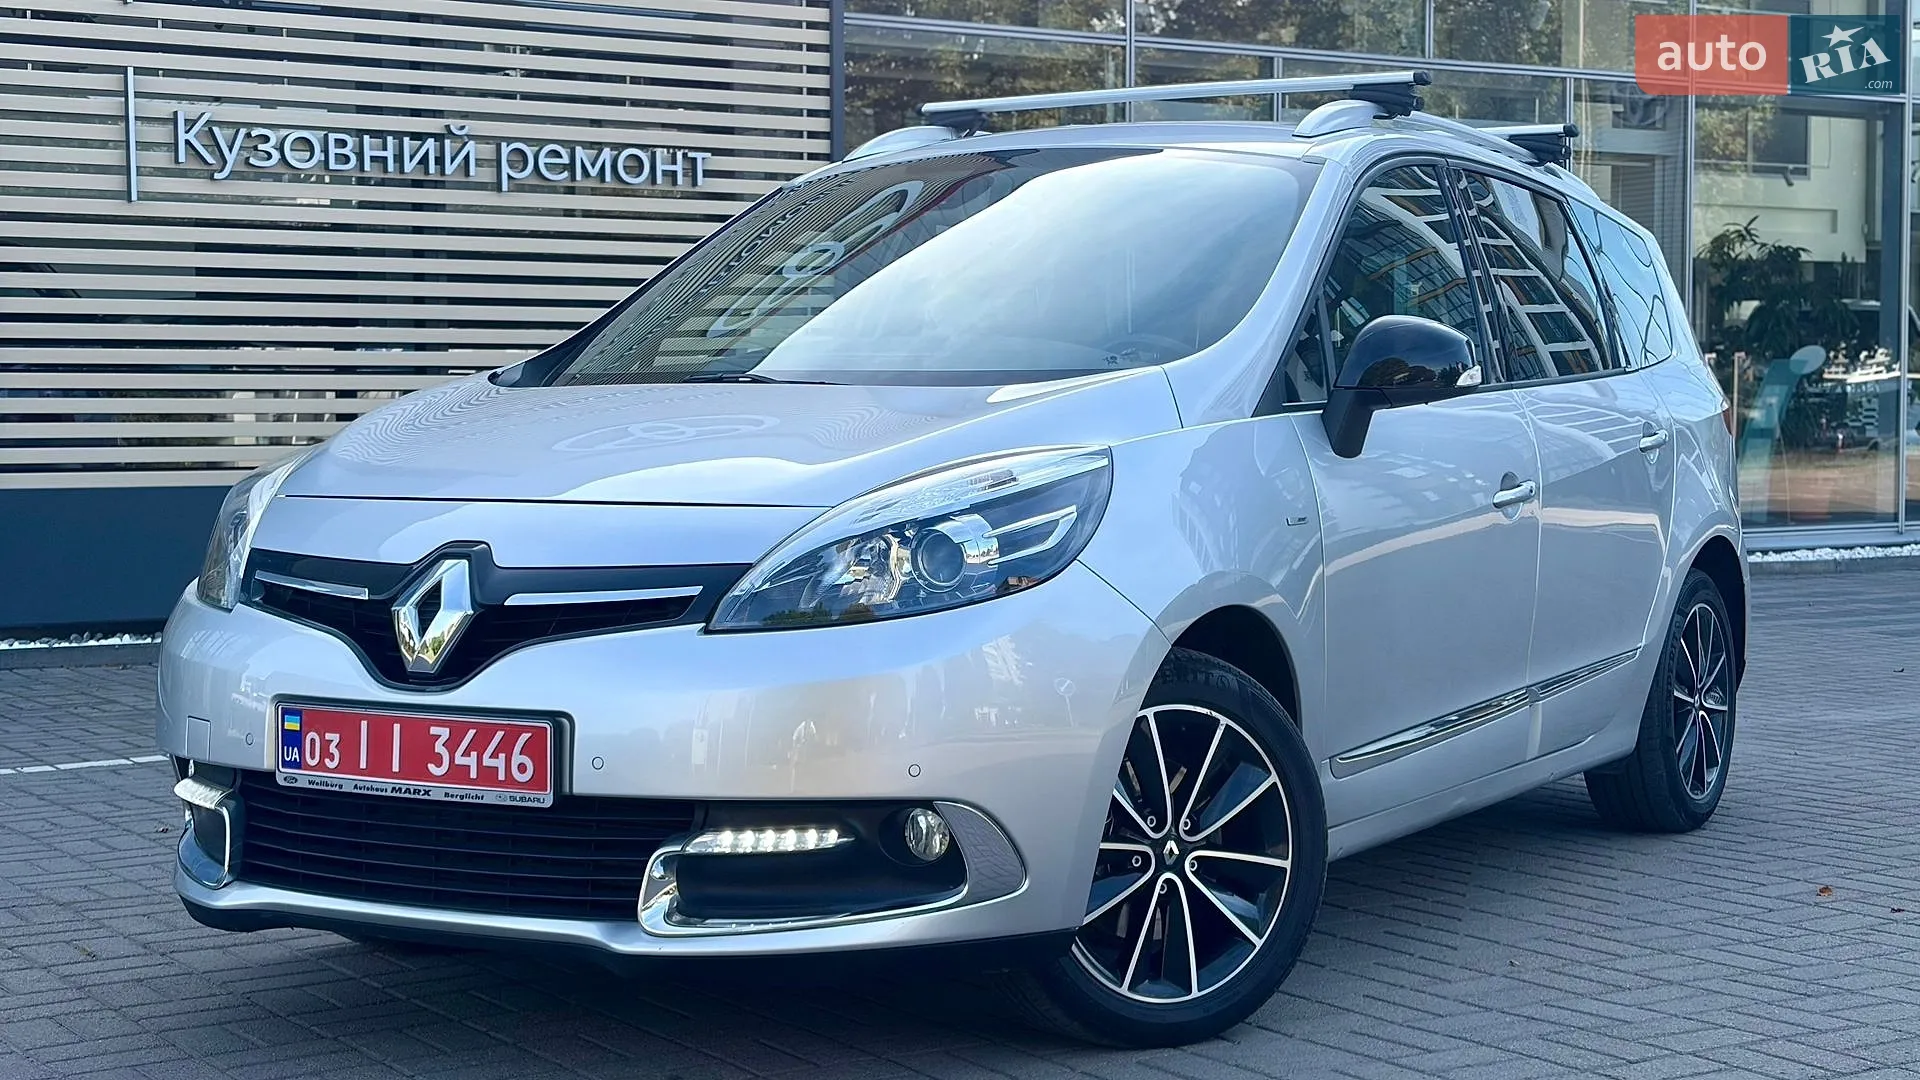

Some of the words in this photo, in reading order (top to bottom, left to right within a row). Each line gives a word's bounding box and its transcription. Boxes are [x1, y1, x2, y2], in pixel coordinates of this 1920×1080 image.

[174, 109, 477, 180] Кузовний
[499, 140, 712, 193] ремонт
[283, 745, 300, 763] UA
[305, 731, 341, 769] 03
[427, 726, 534, 783] 3446
[353, 783, 388, 794] Autohaus
[390, 786, 433, 797] MARX
[508, 795, 546, 804] SUBARU
